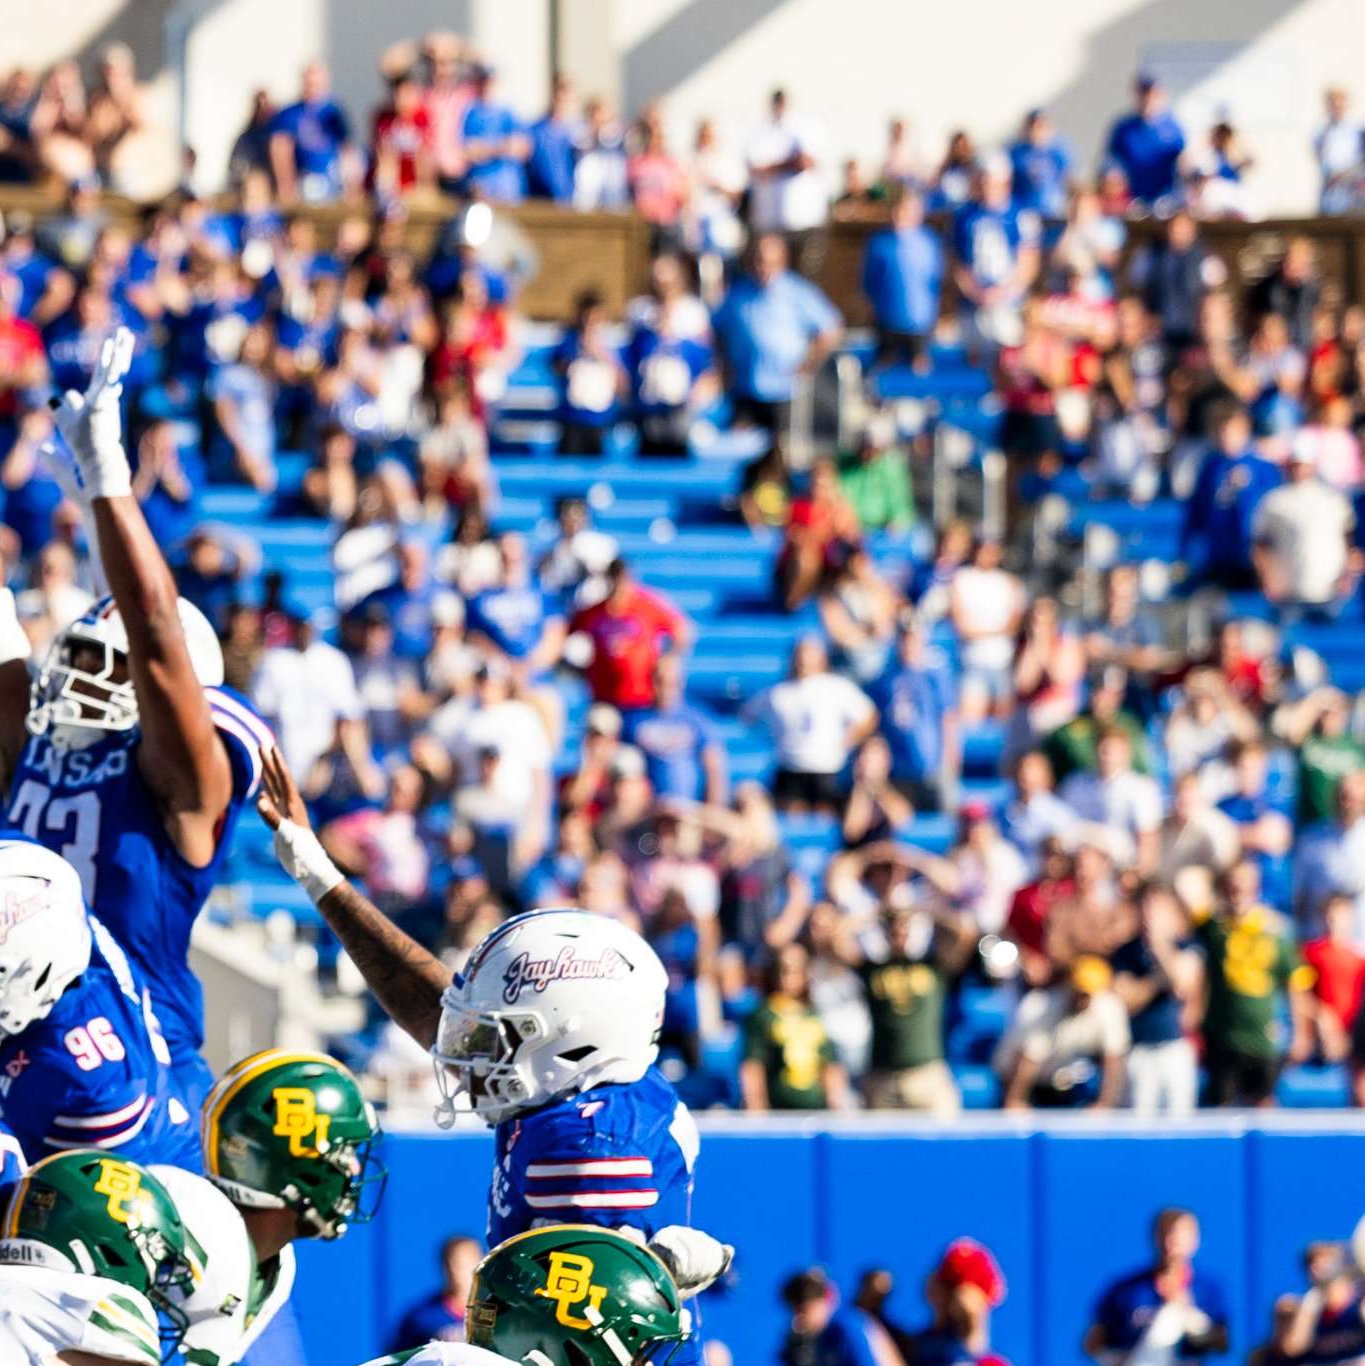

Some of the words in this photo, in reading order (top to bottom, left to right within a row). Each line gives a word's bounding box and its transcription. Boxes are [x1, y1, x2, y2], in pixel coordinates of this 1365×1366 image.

[64, 1016, 125, 1071] 96
[273, 1088, 331, 1158] BU
[534, 1252, 607, 1330] BU
